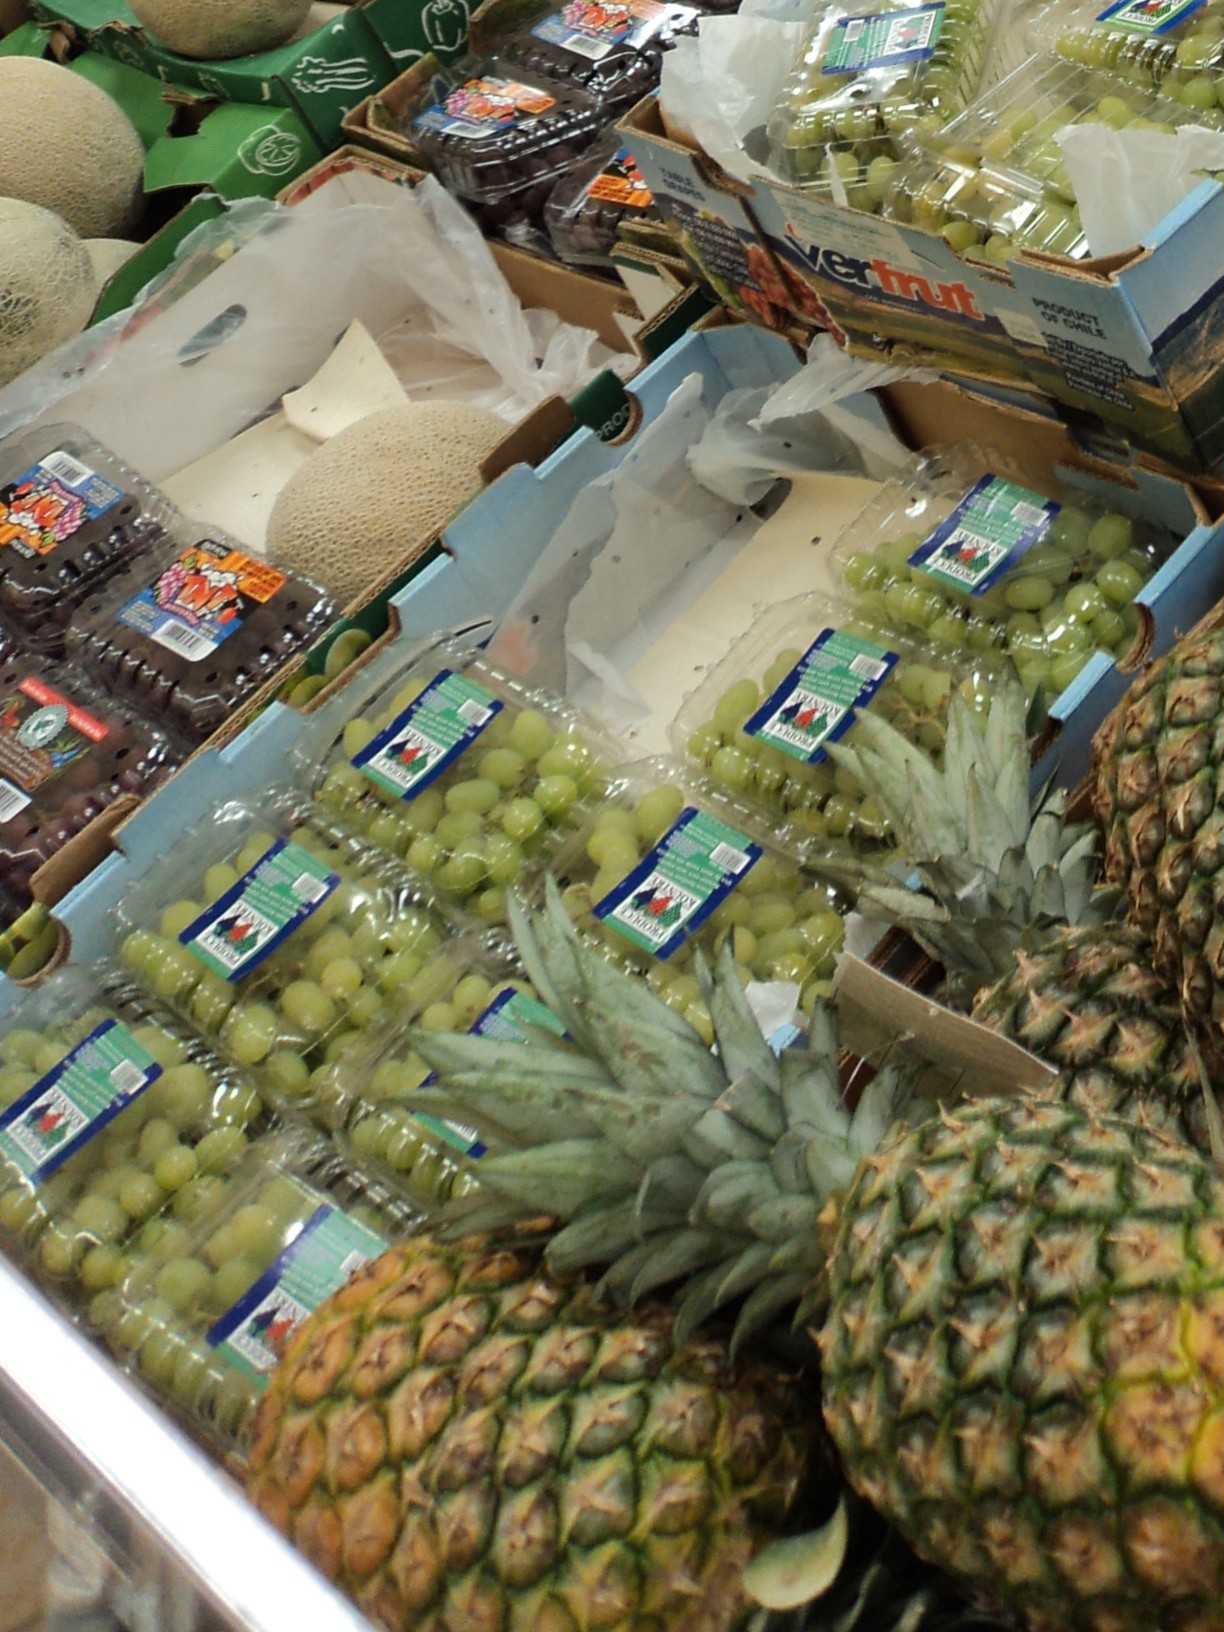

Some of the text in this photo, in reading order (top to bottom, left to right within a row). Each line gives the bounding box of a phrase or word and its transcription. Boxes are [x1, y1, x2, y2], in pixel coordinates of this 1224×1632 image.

[786, 236, 980, 317] verfrut
[1034, 297, 1098, 327] PRODUCT
[1042, 311, 1106, 340] OF CHILE
[930, 557, 978, 582] PRODUCE
[792, 689, 841, 717] KOUNTRY
[768, 720, 815, 750] PRODUCE
[648, 873, 697, 908] KOUNTRY
[617, 905, 665, 941] PRODUCE
